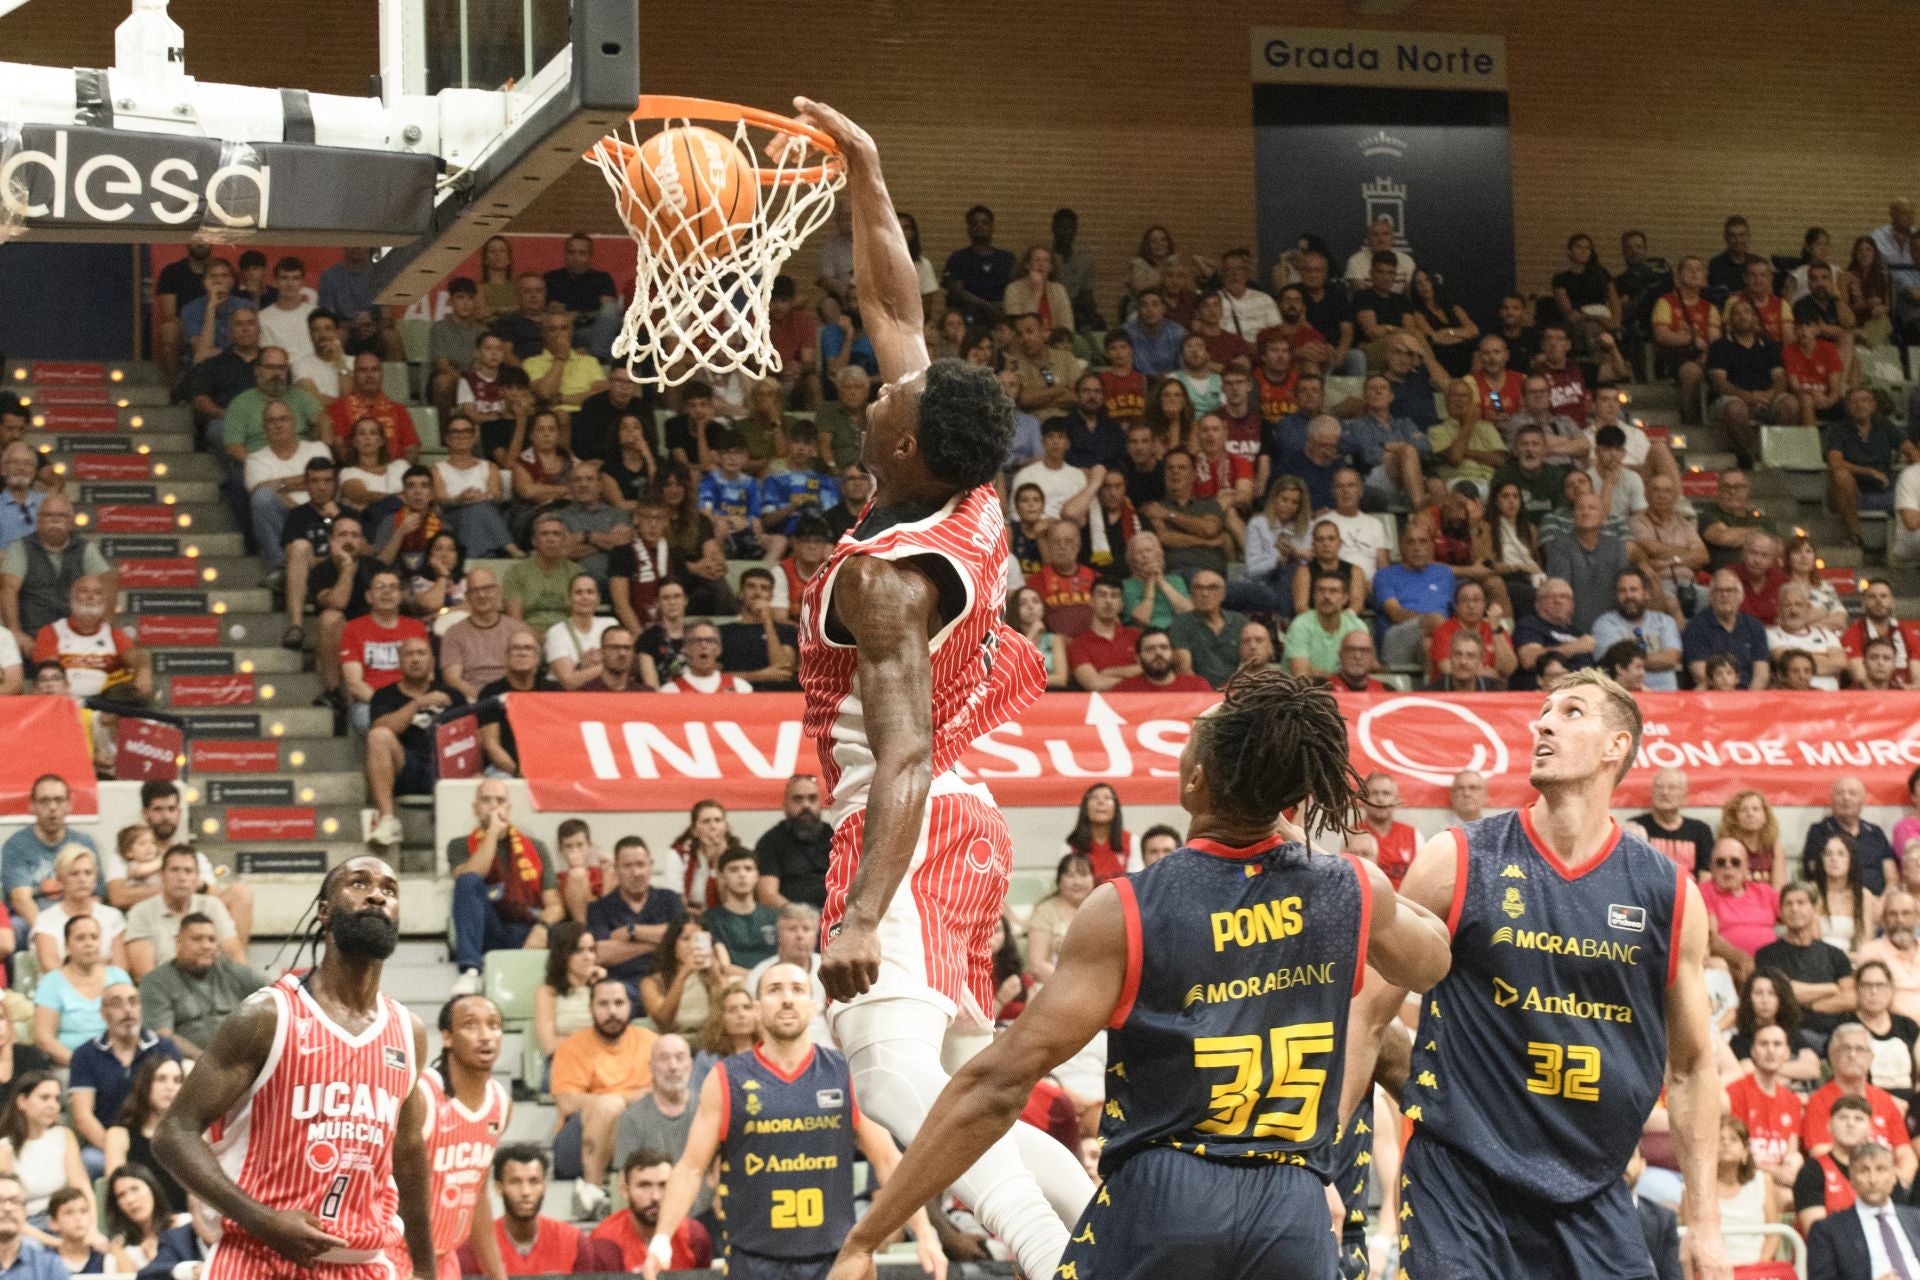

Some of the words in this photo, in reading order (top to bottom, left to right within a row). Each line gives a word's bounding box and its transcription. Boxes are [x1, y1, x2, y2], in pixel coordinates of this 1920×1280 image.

[1263, 39, 1380, 70] Grada
[1397, 44, 1494, 75] Norte
[0, 130, 271, 228] desa
[1722, 740, 1792, 767] DE
[1211, 896, 1303, 952] PONS
[1515, 929, 1641, 965] MORABANC
[1206, 962, 1336, 1004] MORABANC
[1521, 986, 1632, 1023] Andorra
[1193, 1021, 1334, 1142] 35
[1526, 1041, 1600, 1102] 32
[306, 1121, 384, 1148] MURCIA
[323, 1175, 349, 1218] 8
[771, 1188, 824, 1229] 20
